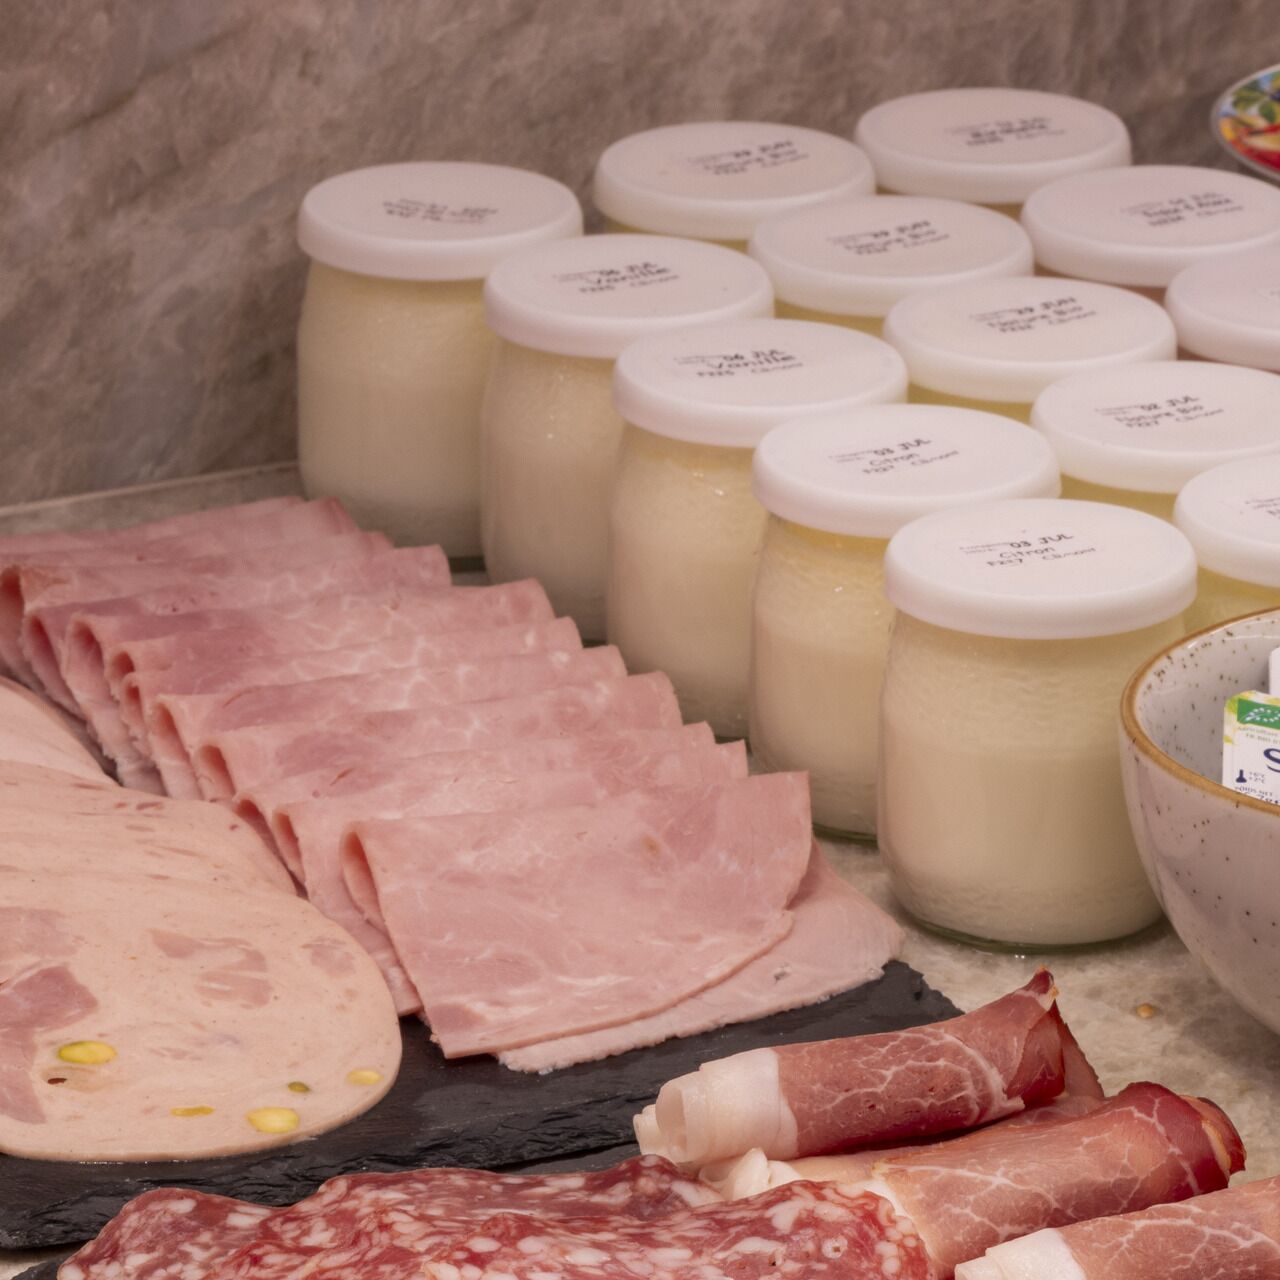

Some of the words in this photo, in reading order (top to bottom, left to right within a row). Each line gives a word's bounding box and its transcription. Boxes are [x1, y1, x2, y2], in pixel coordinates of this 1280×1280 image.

[706, 355, 797, 370] Vanille
[1166, 395, 1200, 408] JUL
[1114, 411, 1175, 424] Nature
[1176, 404, 1204, 415] Bio
[897, 438, 932, 451] JUL
[868, 453, 921, 467] Citron
[1009, 540, 1032, 549] 03
[1038, 533, 1075, 546] JUL
[999, 546, 1056, 560] Citron
